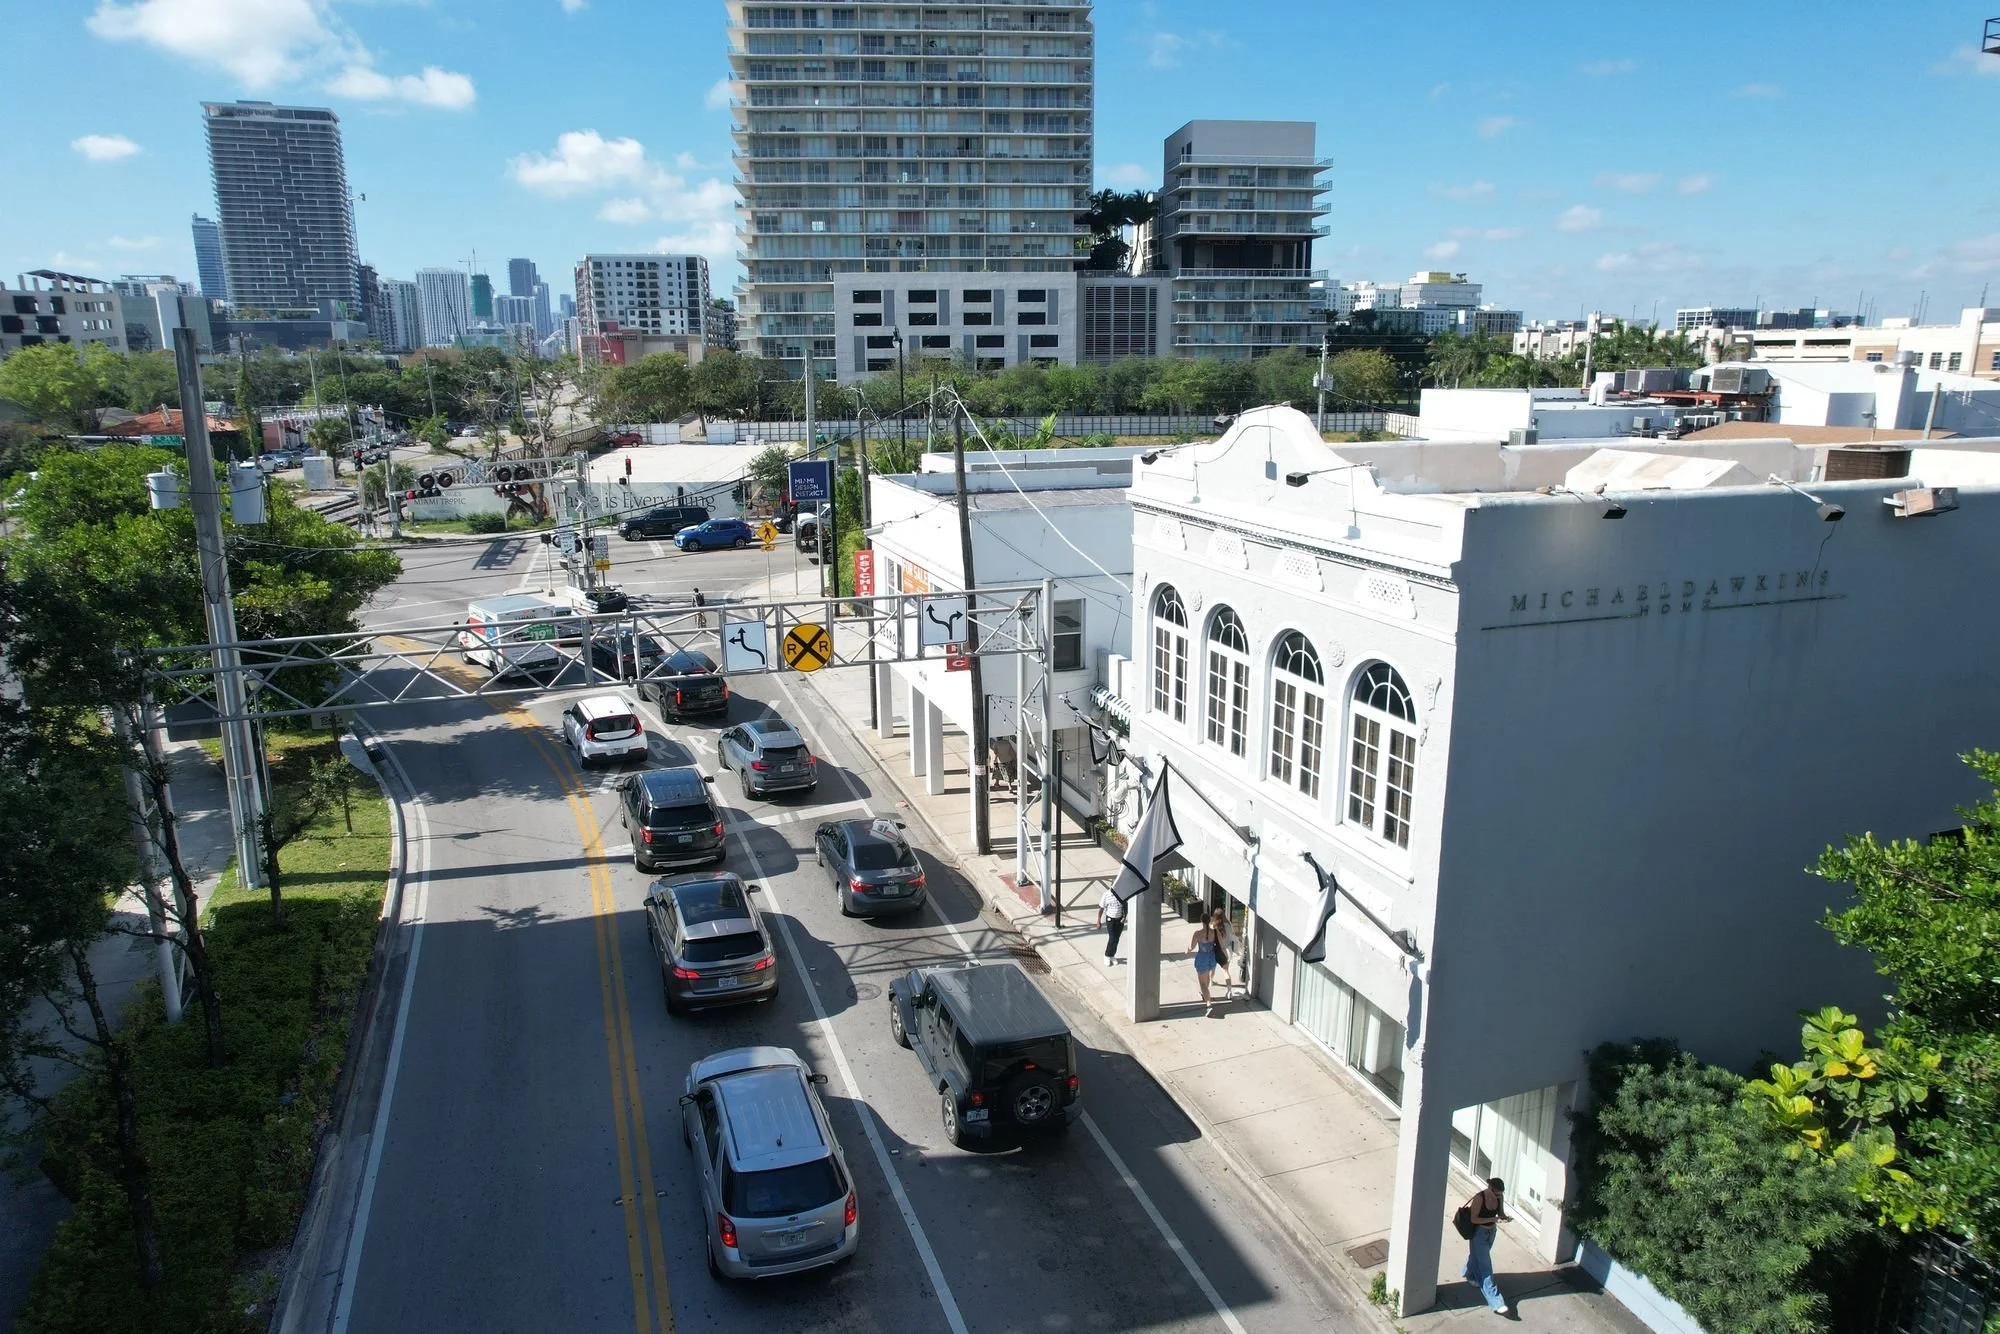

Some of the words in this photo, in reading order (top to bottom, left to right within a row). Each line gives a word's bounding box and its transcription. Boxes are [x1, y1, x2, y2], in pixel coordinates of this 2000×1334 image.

[605, 492, 618, 508] is
[859, 554, 871, 597] PSYCHIC
[1510, 582, 1671, 612] MICHAEL
[1682, 570, 1830, 598] DAWKINS
[787, 643, 797, 655] R
[819, 640, 829, 652] R
[687, 735, 719, 755] R
